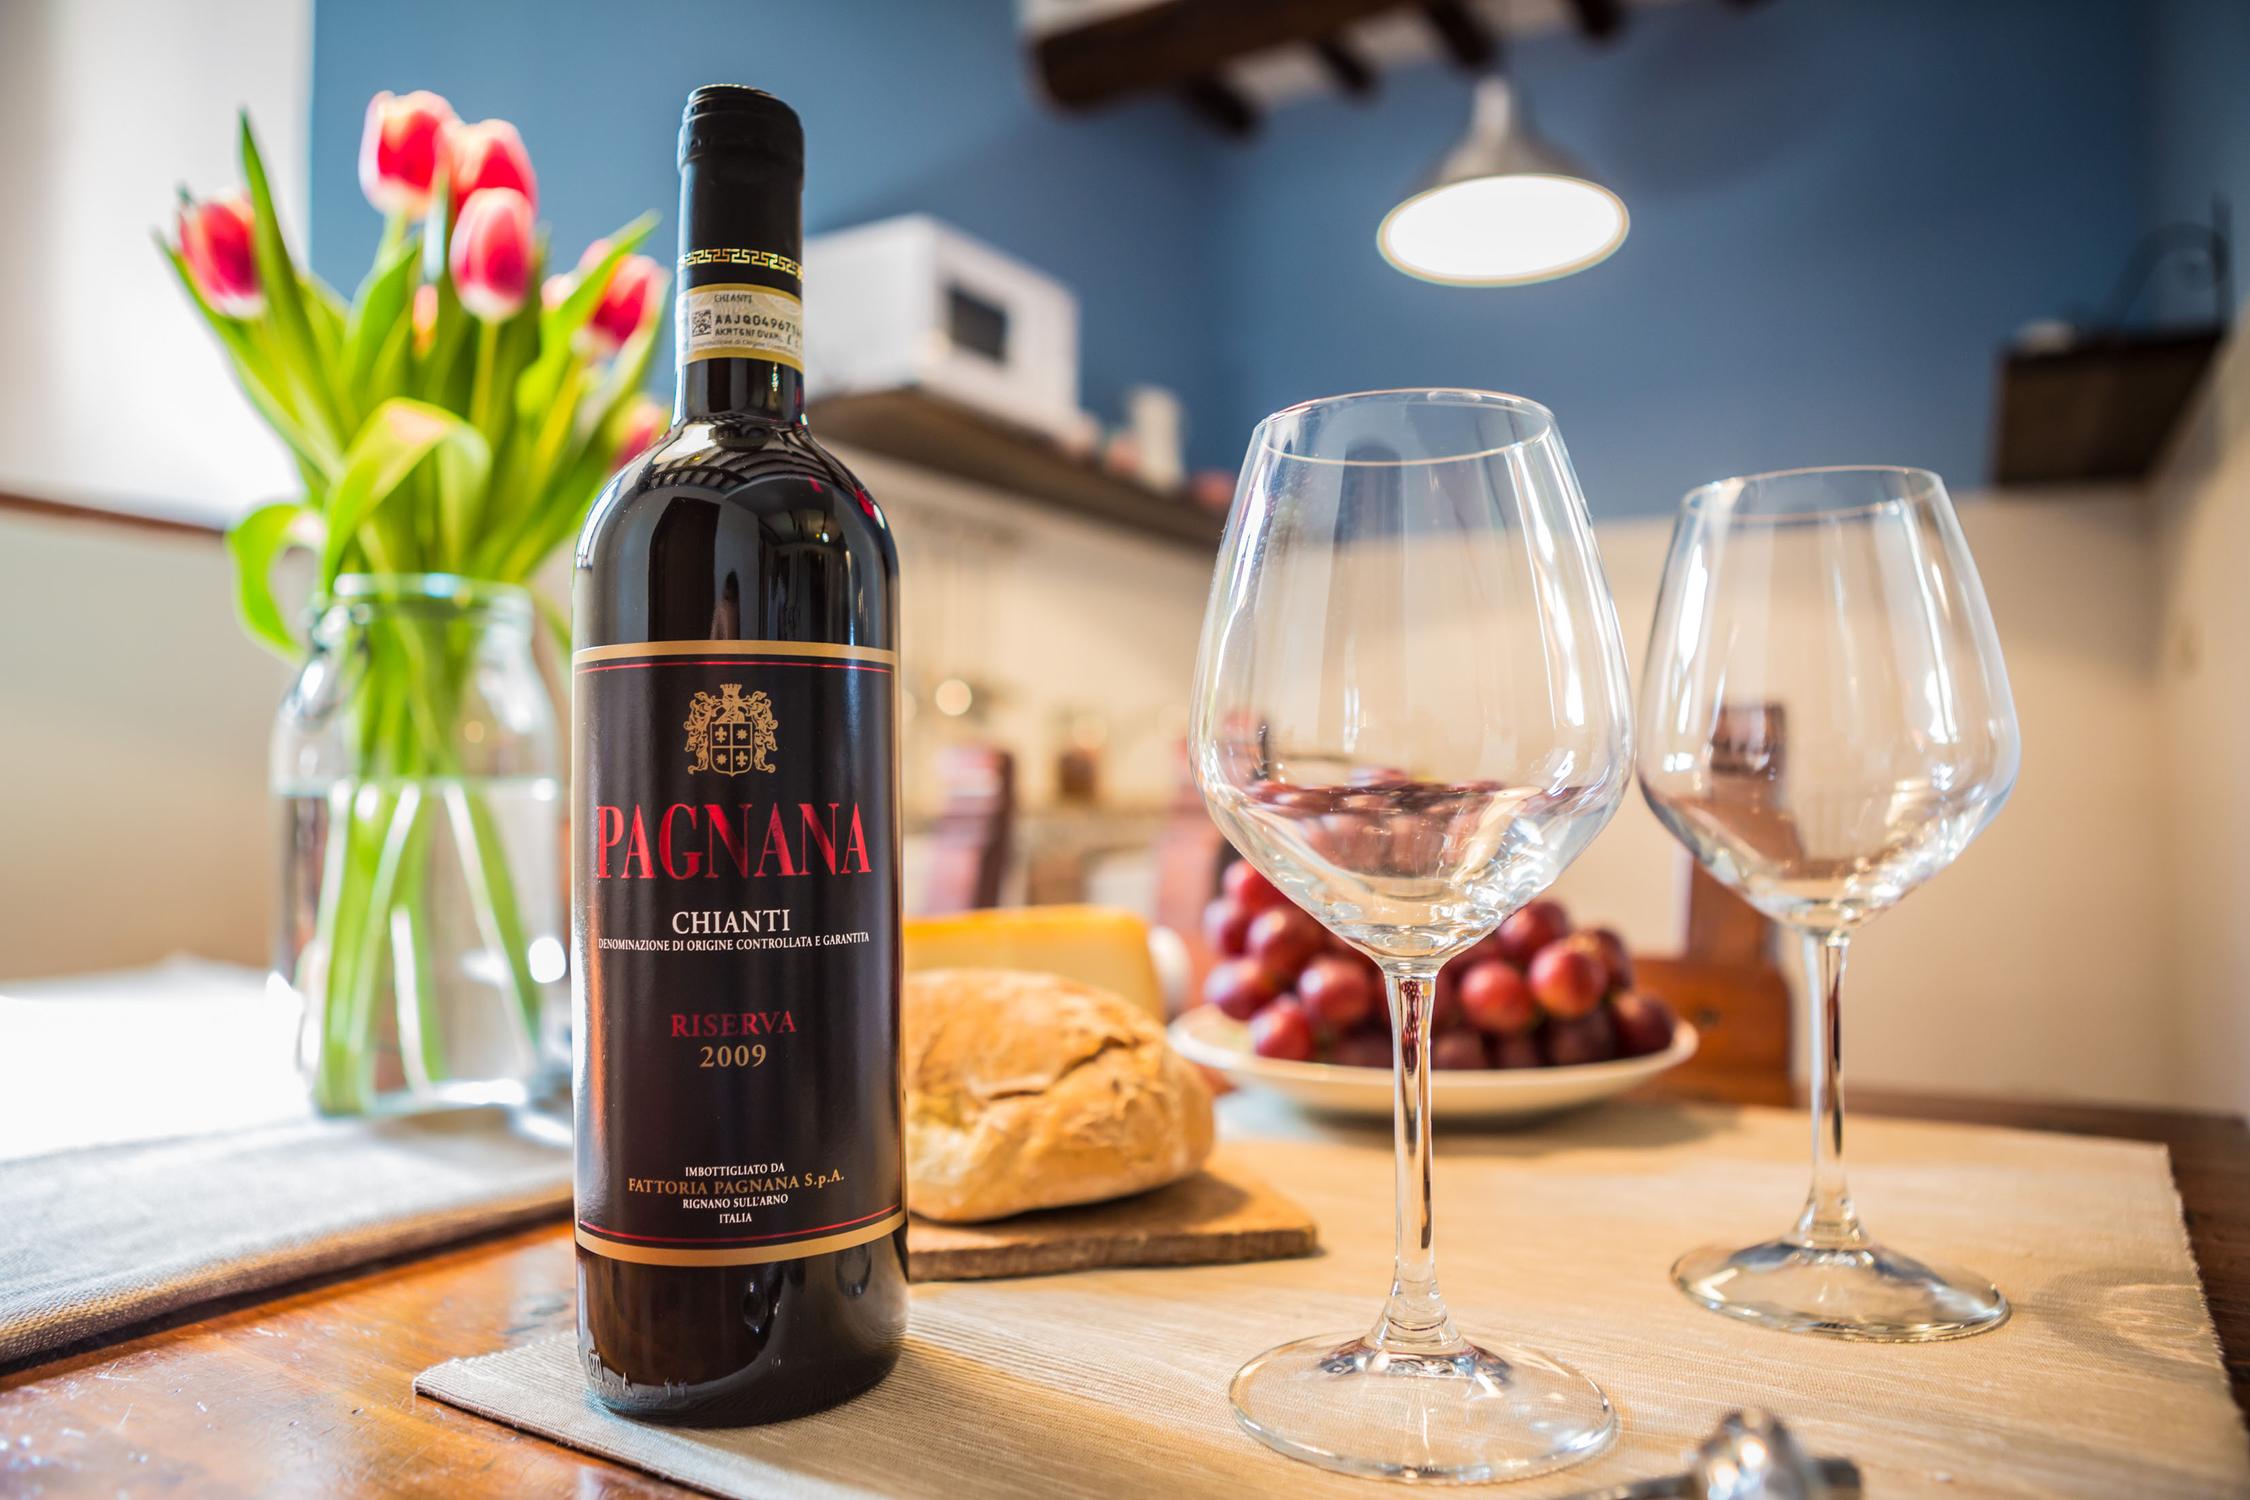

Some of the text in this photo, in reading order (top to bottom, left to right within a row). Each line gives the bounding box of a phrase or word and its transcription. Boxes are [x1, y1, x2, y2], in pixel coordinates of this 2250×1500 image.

[596, 802, 872, 880] PAGNANA
[672, 909, 791, 934] CHIANTI
[598, 932, 870, 951] DENOMINAZIONE DI ORIGINE CONTROLLATA E GARANTITA
[671, 1010, 797, 1038] RISERVA
[700, 1044, 767, 1068] 2009
[628, 1168, 845, 1195] FATTORIA PAGNANA S.p.A.
[685, 1163, 785, 1177] IMBOTTIGLIATO DA
[682, 1199, 731, 1209] RIGNANO
[719, 1212, 752, 1224] ITALIA
